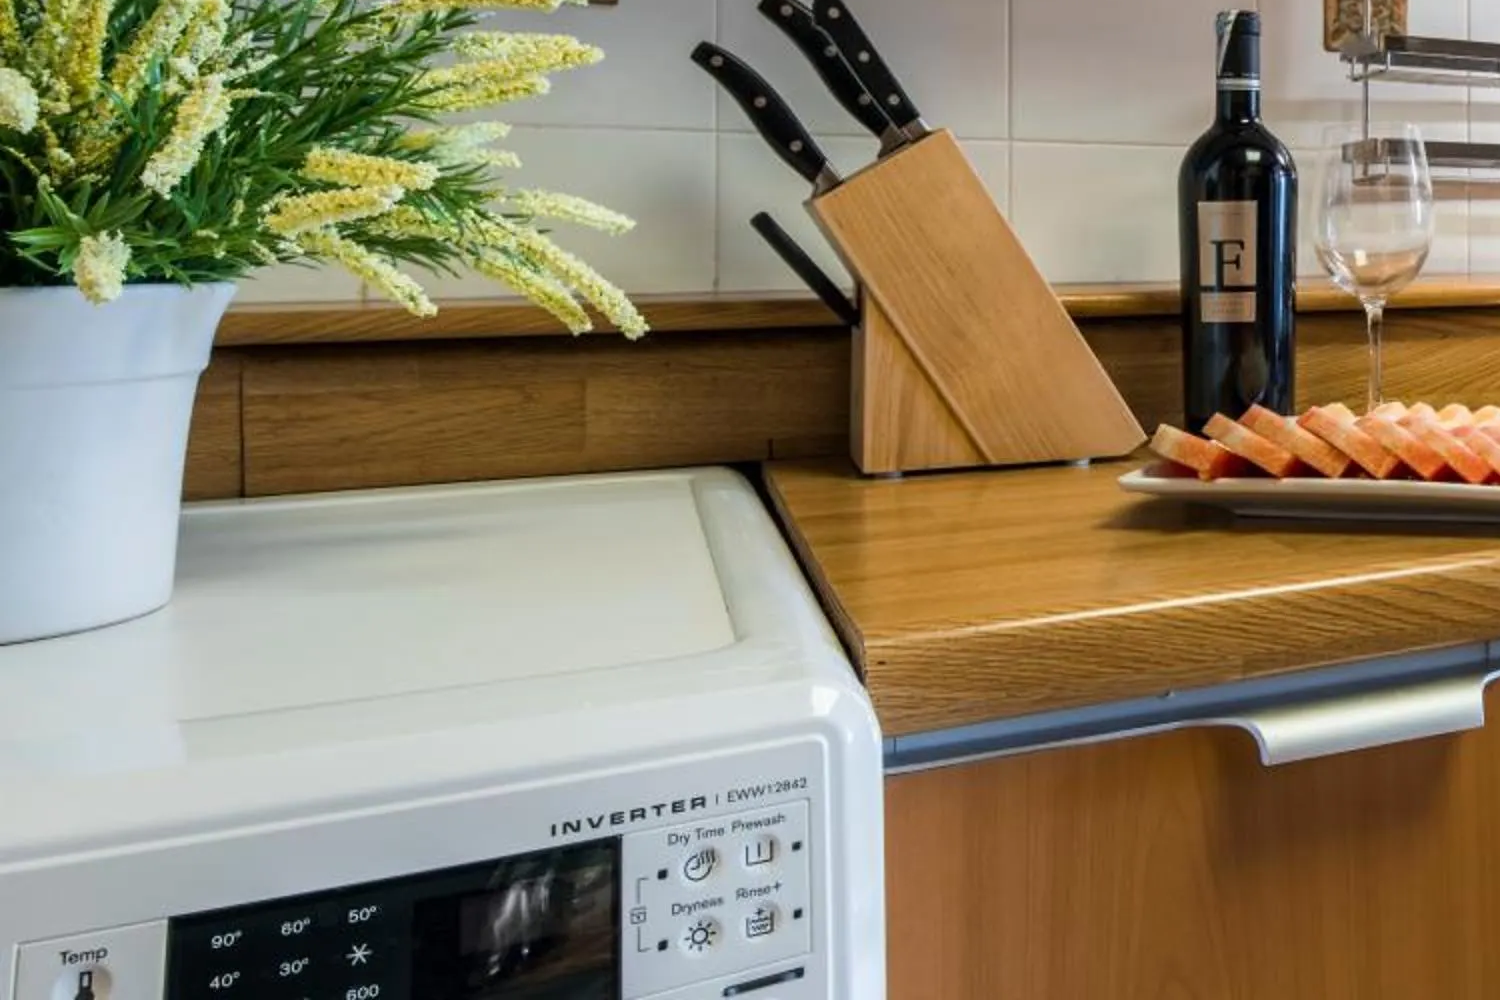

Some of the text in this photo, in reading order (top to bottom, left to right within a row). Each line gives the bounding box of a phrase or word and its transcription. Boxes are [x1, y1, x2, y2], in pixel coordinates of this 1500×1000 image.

[1210, 239, 1245, 293] F
[551, 777, 808, 837] INVERTER EWW12842
[731, 813, 786, 834] Prewash
[667, 826, 726, 846] Dry Time
[348, 905, 377, 924] 50°
[671, 897, 724, 917] Dryness
[281, 917, 311, 937] 60°
[211, 930, 243, 950] 90°
[60, 947, 109, 965] Temp
[279, 957, 310, 977] 30°
[209, 971, 241, 991] 40°
[346, 984, 380, 1000] 600
